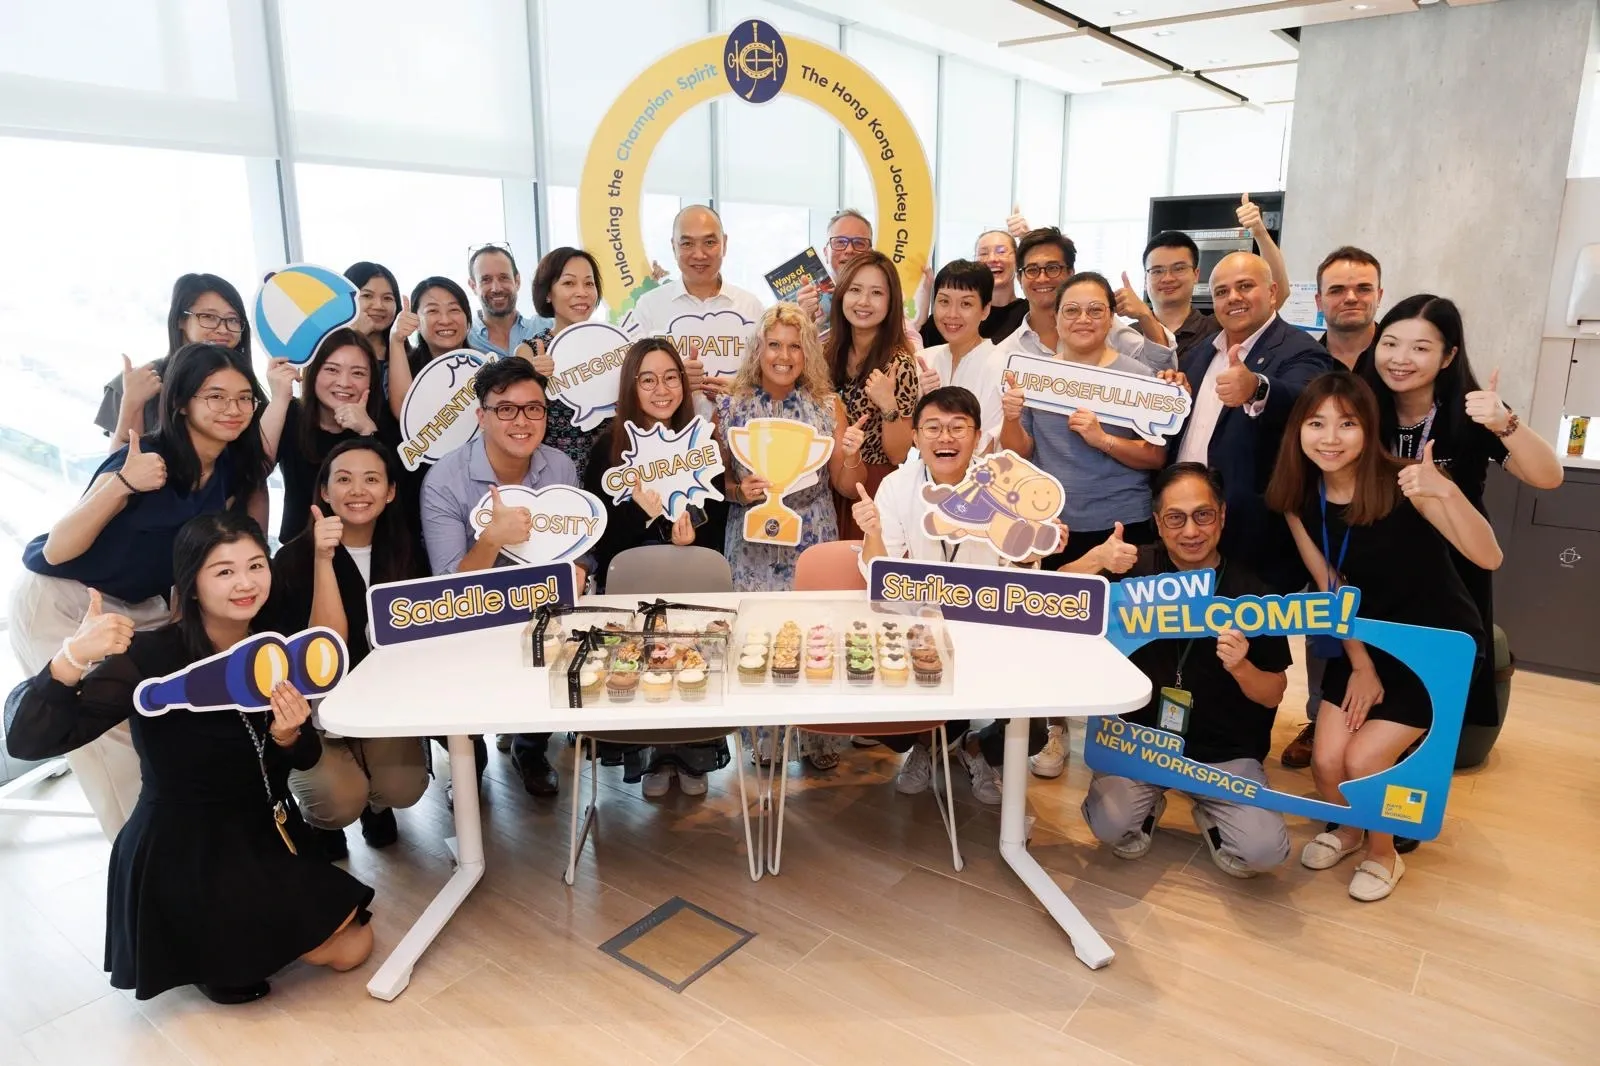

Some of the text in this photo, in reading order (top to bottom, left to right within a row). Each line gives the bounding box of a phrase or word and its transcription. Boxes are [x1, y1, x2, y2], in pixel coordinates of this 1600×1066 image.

[606, 63, 719, 287] Unlocking the Champion Spirit
[801, 65, 908, 264] The Hong Kong Jockey Club
[772, 272, 797, 289] Ways
[795, 264, 806, 276] of
[776, 273, 814, 296] Workig
[546, 341, 635, 396] INTEGRIT
[606, 445, 717, 491] COURAGE
[475, 508, 599, 536] COSITY
[390, 577, 558, 628] Saddle up!
[883, 574, 1091, 619] Strike a Pose!
[1126, 572, 1211, 604] WOW
[1119, 592, 1356, 635] WELCOME!
[1101, 717, 1182, 752] TO YOUR
[1095, 731, 1258, 799] NEW WORKSPACE
